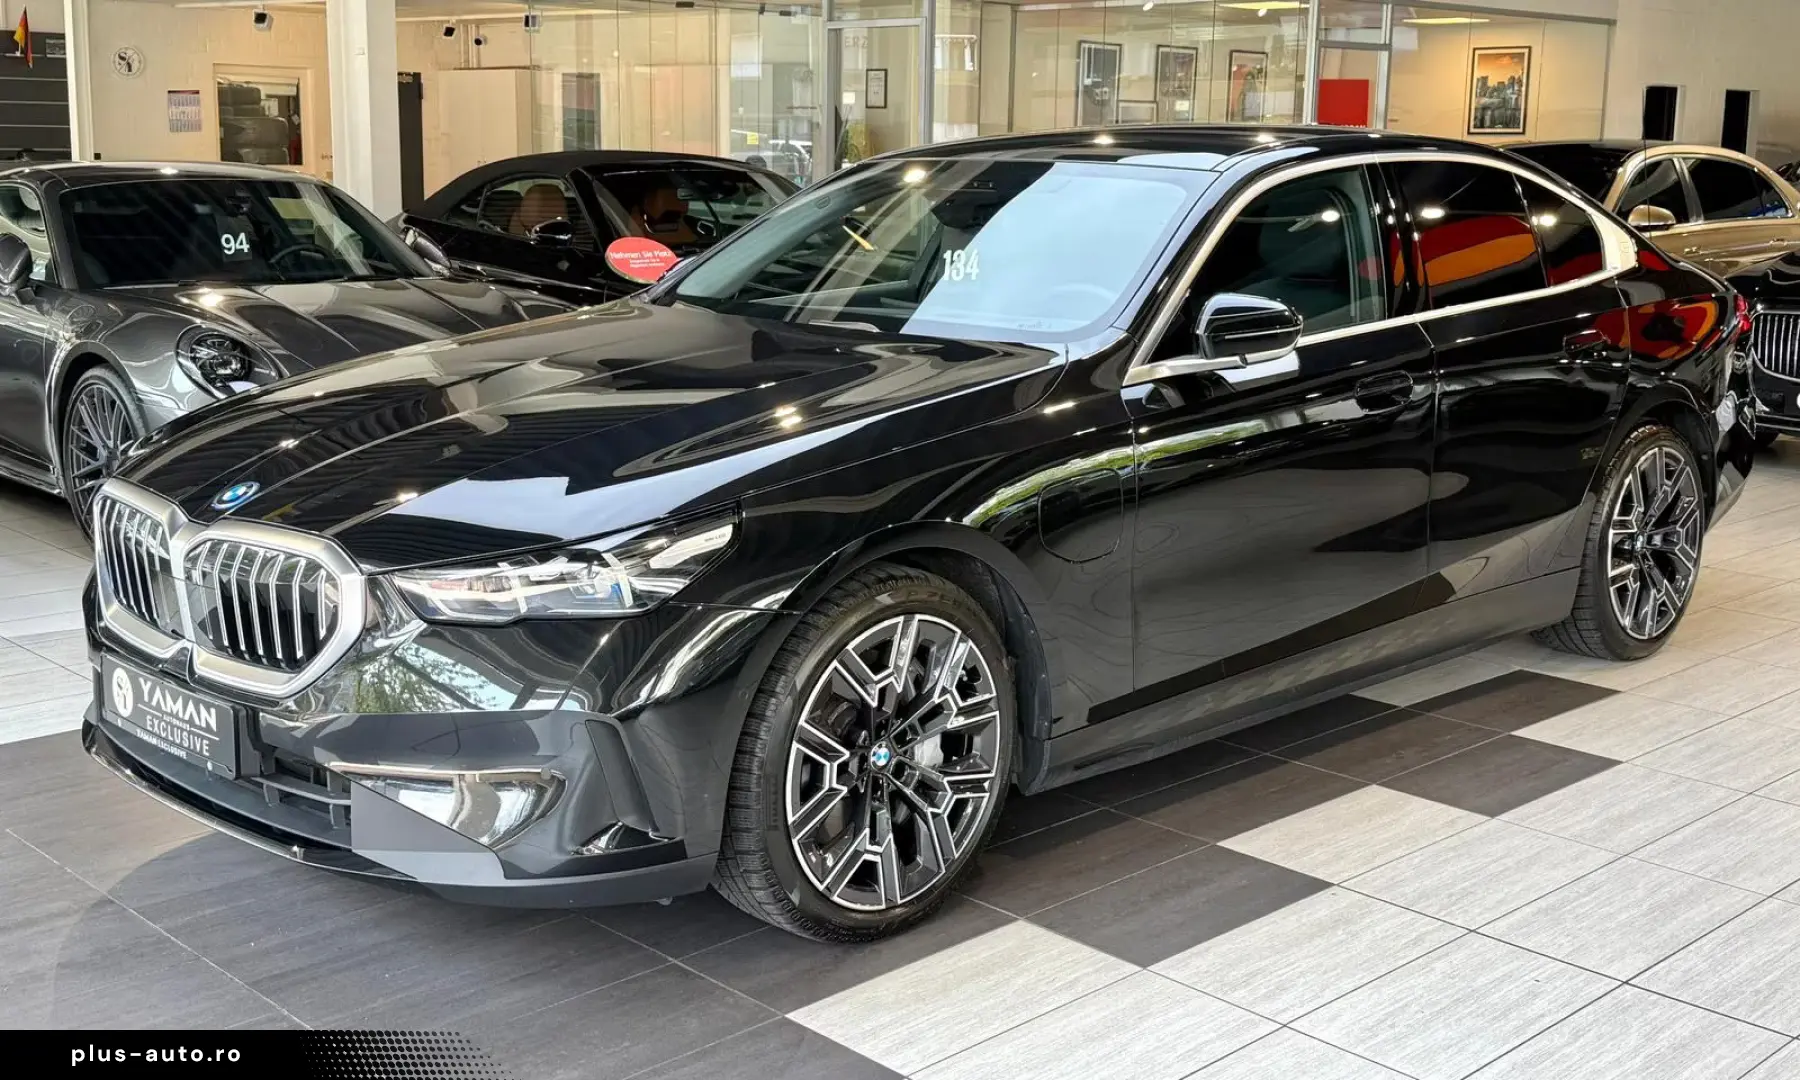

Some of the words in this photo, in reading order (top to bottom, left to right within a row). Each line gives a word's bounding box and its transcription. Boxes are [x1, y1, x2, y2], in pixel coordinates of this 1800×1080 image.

[221, 232, 250, 255] 94
[610, 251, 641, 260] Nehmen
[641, 250, 654, 258] Sie
[943, 249, 980, 281] 134
[138, 677, 217, 732] YAMAN
[146, 714, 210, 757] EXCLUSIVE
